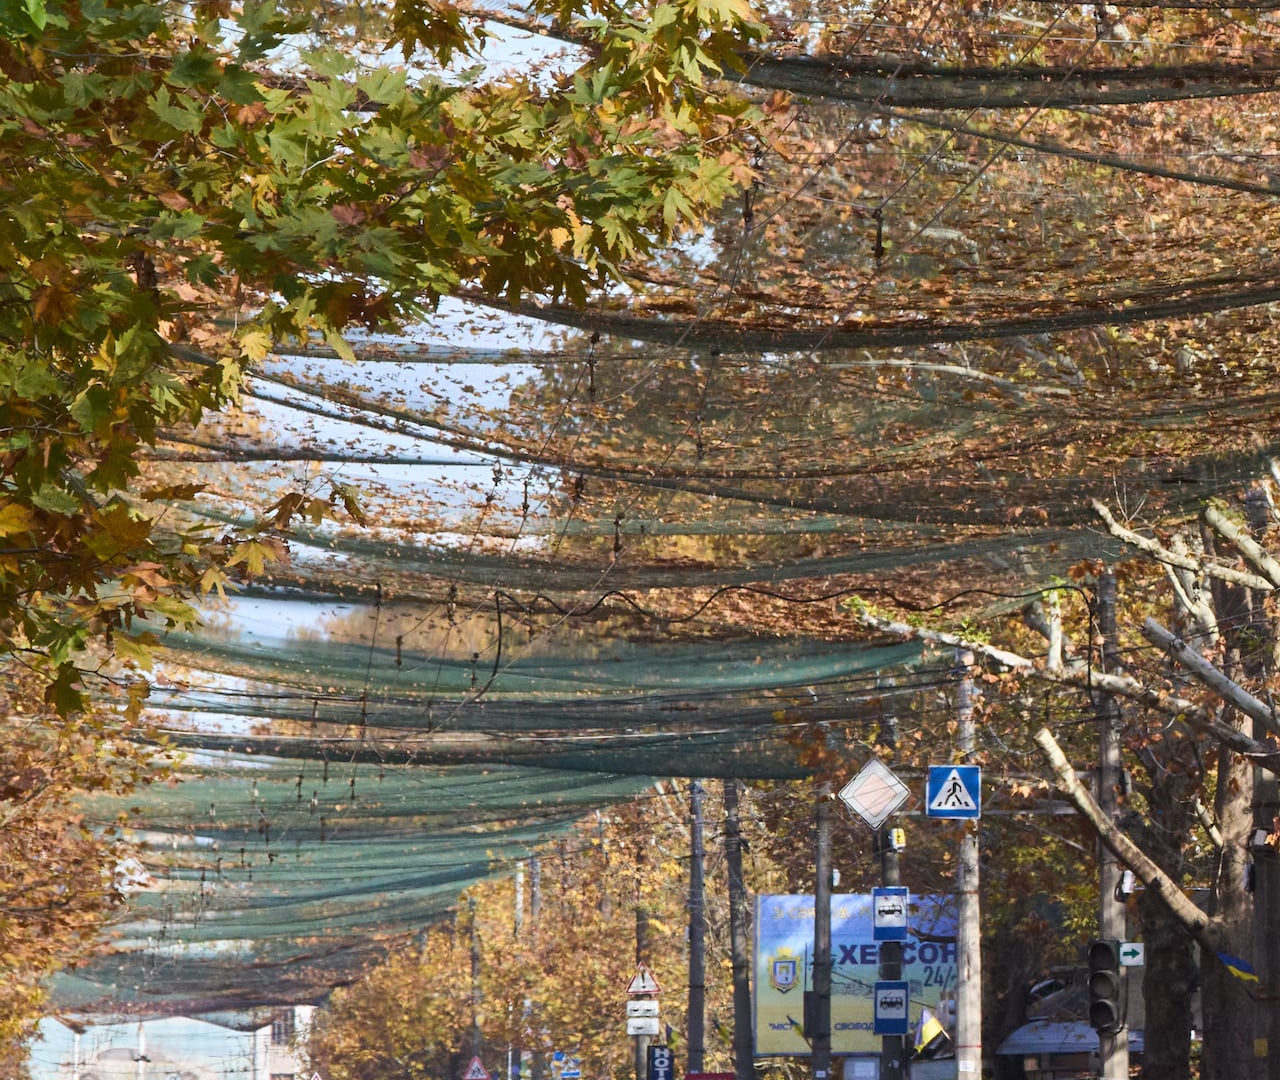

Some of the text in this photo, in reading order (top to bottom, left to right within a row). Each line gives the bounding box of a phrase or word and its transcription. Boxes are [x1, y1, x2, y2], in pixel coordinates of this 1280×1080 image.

[838, 943, 958, 965] ХЕСОН
[923, 965, 957, 992] 24/
[654, 1048, 669, 1080] HOT
